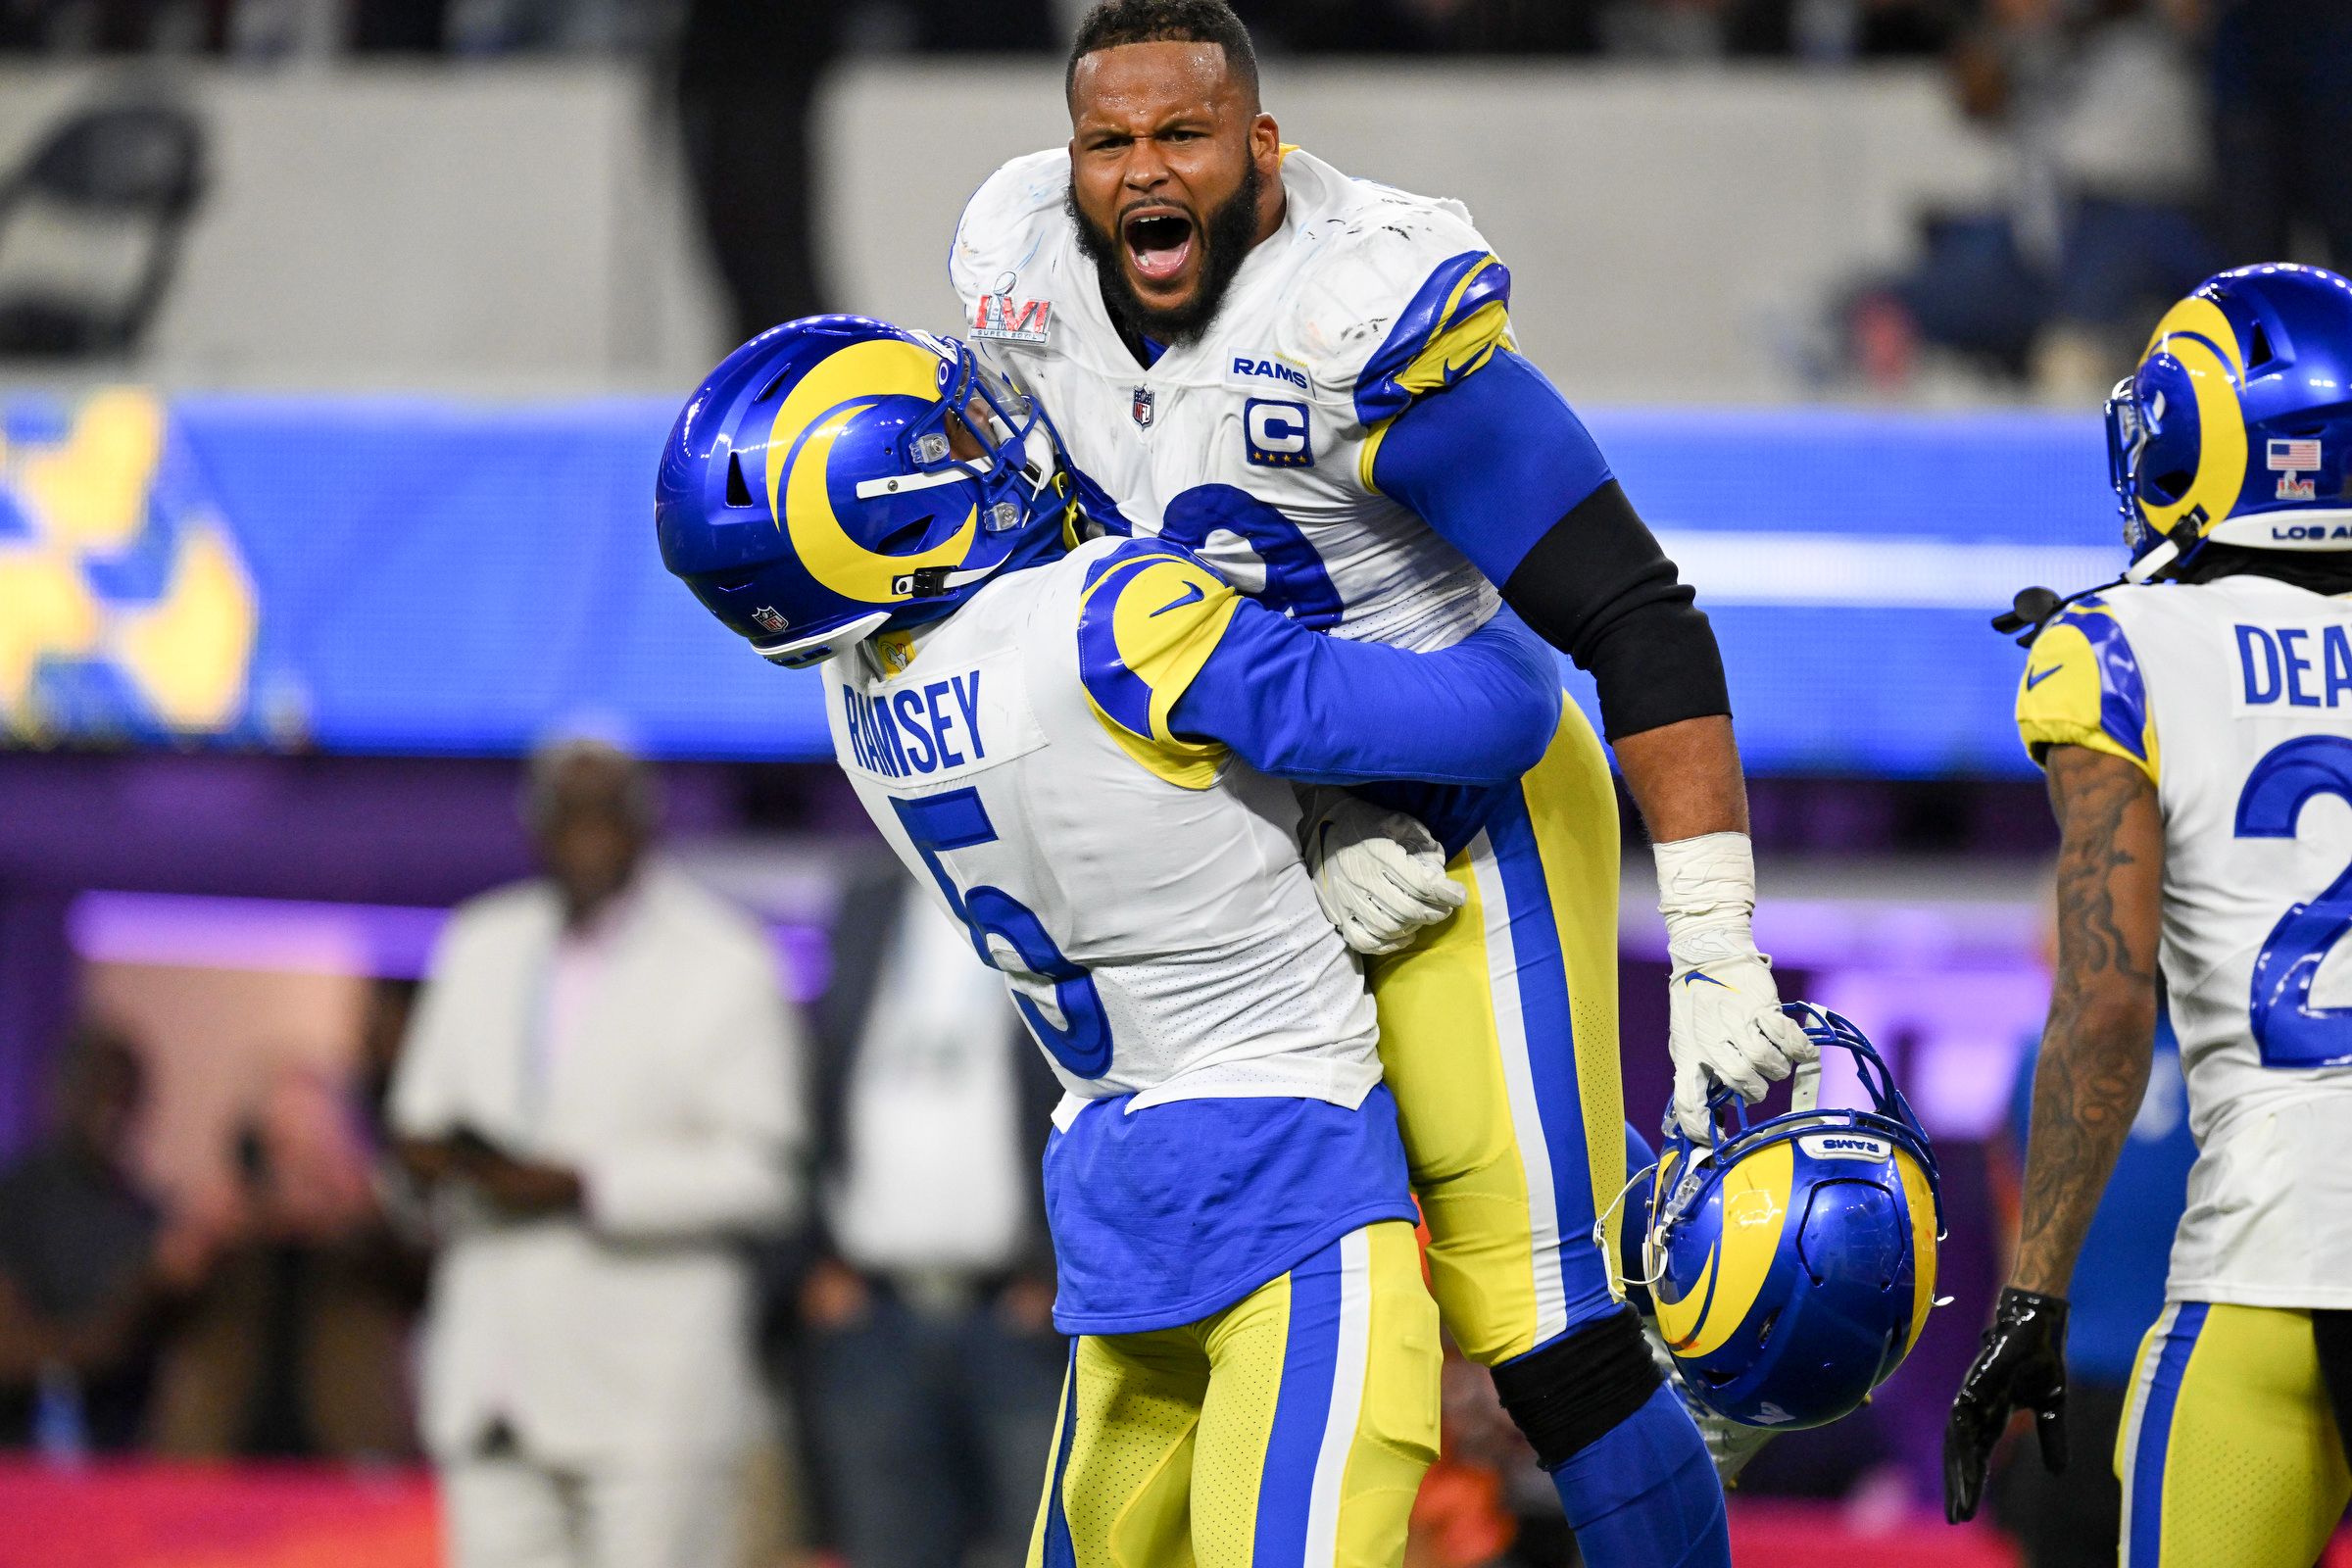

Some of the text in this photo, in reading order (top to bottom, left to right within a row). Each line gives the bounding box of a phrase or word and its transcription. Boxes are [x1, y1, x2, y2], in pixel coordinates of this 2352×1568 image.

[976, 294, 1051, 333] LVI
[977, 329, 1007, 338] SUPER
[1233, 357, 1308, 389] RAMS
[1249, 403, 1305, 453] C
[2272, 525, 2327, 540] LOS
[843, 669, 985, 778] RAMSEY
[2233, 734, 2352, 1069] 2
[887, 785, 1114, 1079] 5
[1823, 1139, 1880, 1153] RAMS
